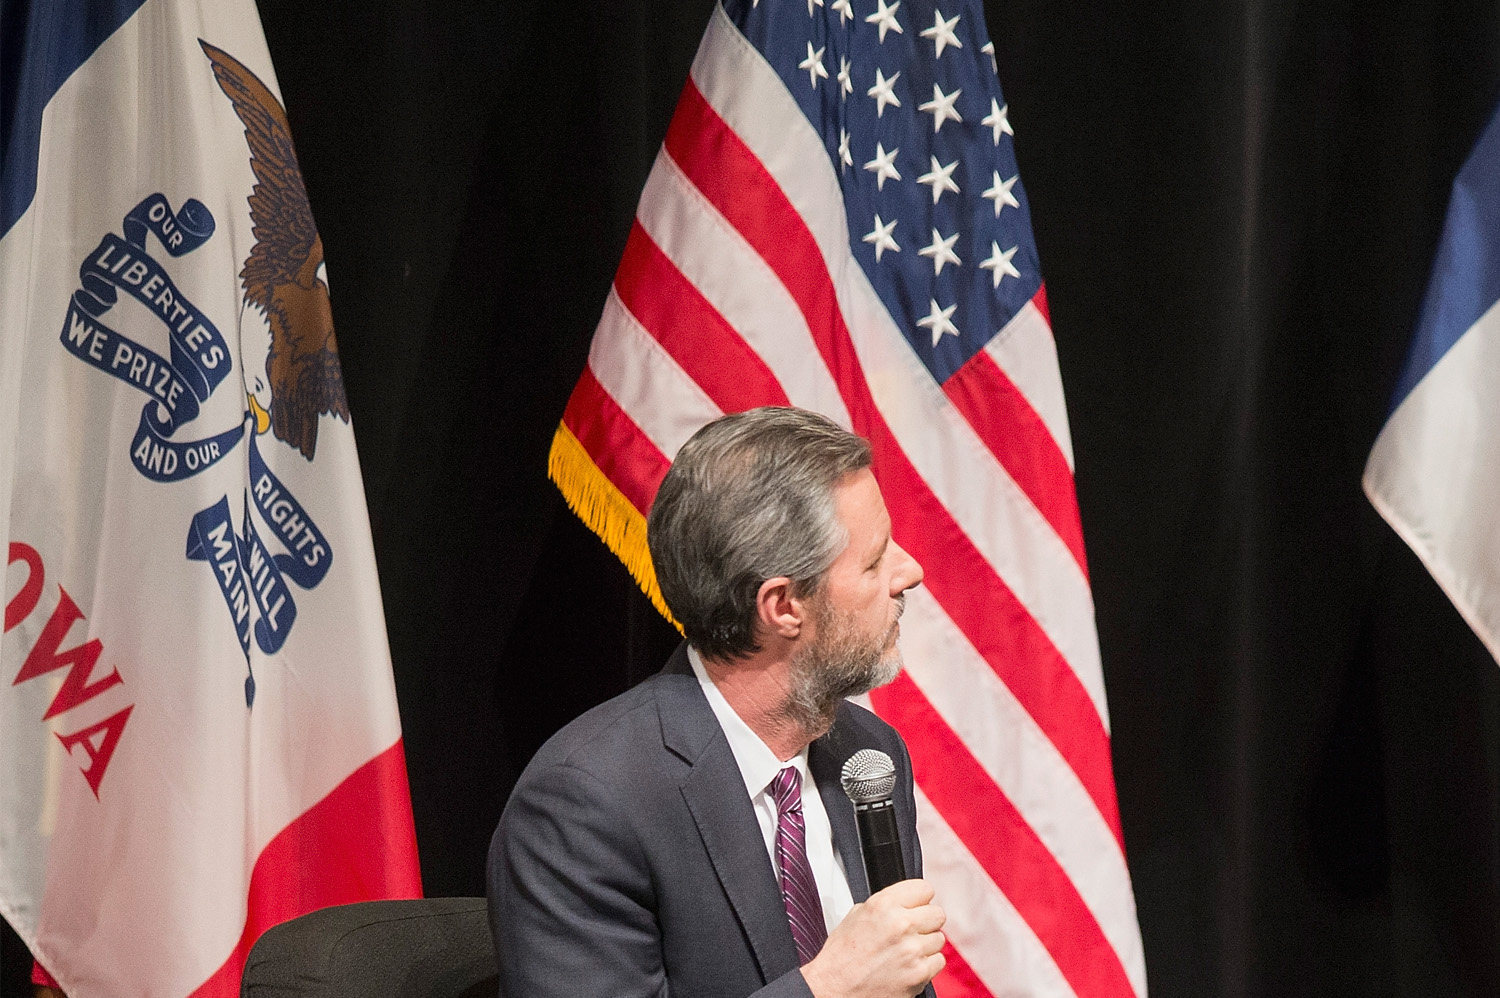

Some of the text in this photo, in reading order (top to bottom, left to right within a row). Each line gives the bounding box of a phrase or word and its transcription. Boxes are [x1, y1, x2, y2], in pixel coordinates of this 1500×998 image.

[149, 202, 184, 249] OUR
[97, 244, 224, 369] LIBERTIES
[68, 311, 184, 411] WE PRIZE
[134, 436, 220, 476] AND OUR
[254, 473, 326, 567] RIGHTS
[207, 520, 251, 644] MAIN
[250, 541, 286, 632] WILL
[4, 541, 135, 803] OWA
